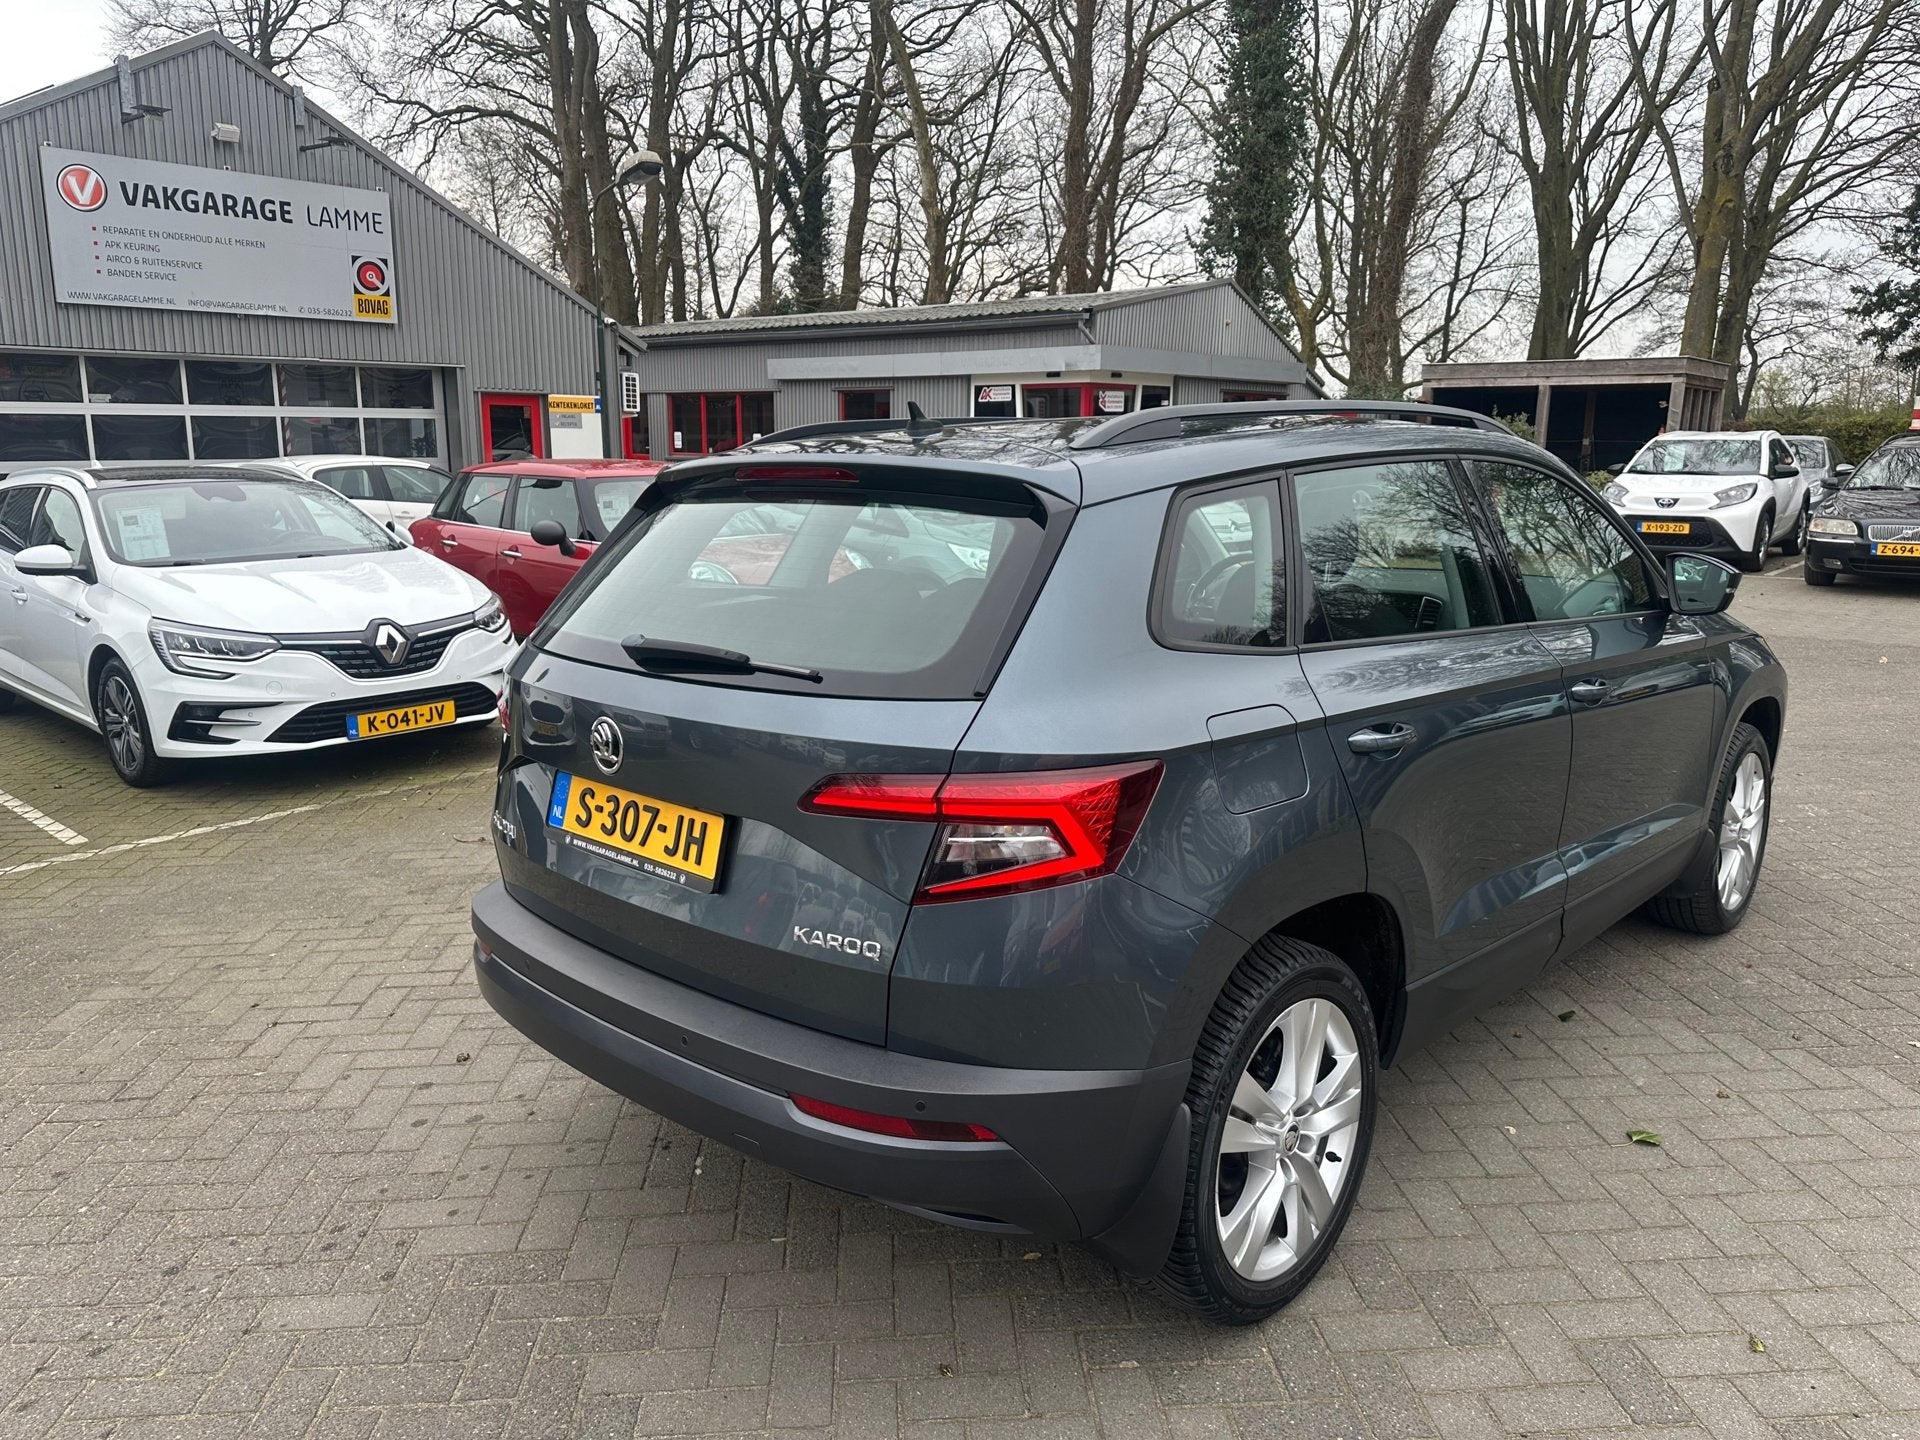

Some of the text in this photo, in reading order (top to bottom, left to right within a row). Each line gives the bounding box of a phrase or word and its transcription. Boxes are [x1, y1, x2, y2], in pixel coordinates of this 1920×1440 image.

[119, 180, 384, 235] VAKGARAGE LAMME
[102, 225, 266, 249] REPARATIE EN ONDERHOUD ALLE MERKEN
[104, 240, 161, 253] APK KEURING
[106, 254, 203, 270] AIRCO & RUITENSERVICE
[107, 268, 177, 282] BANDEN SERVICE
[67, 290, 352, 317] WWW.VAKGARAGELAMME.NL INFO@VAKGARAGELAMME.NL 035-5826232
[357, 298, 389, 316] BOVAG
[549, 401, 594, 410] KENTEKENLOKET
[1646, 523, 1685, 532] X-193-ZD
[1880, 544, 1920, 555] Z-694-
[367, 704, 445, 733] K-041-JV
[552, 804, 563, 820] NL
[575, 786, 708, 867] S-307-JH
[793, 925, 882, 962] KAROQ
